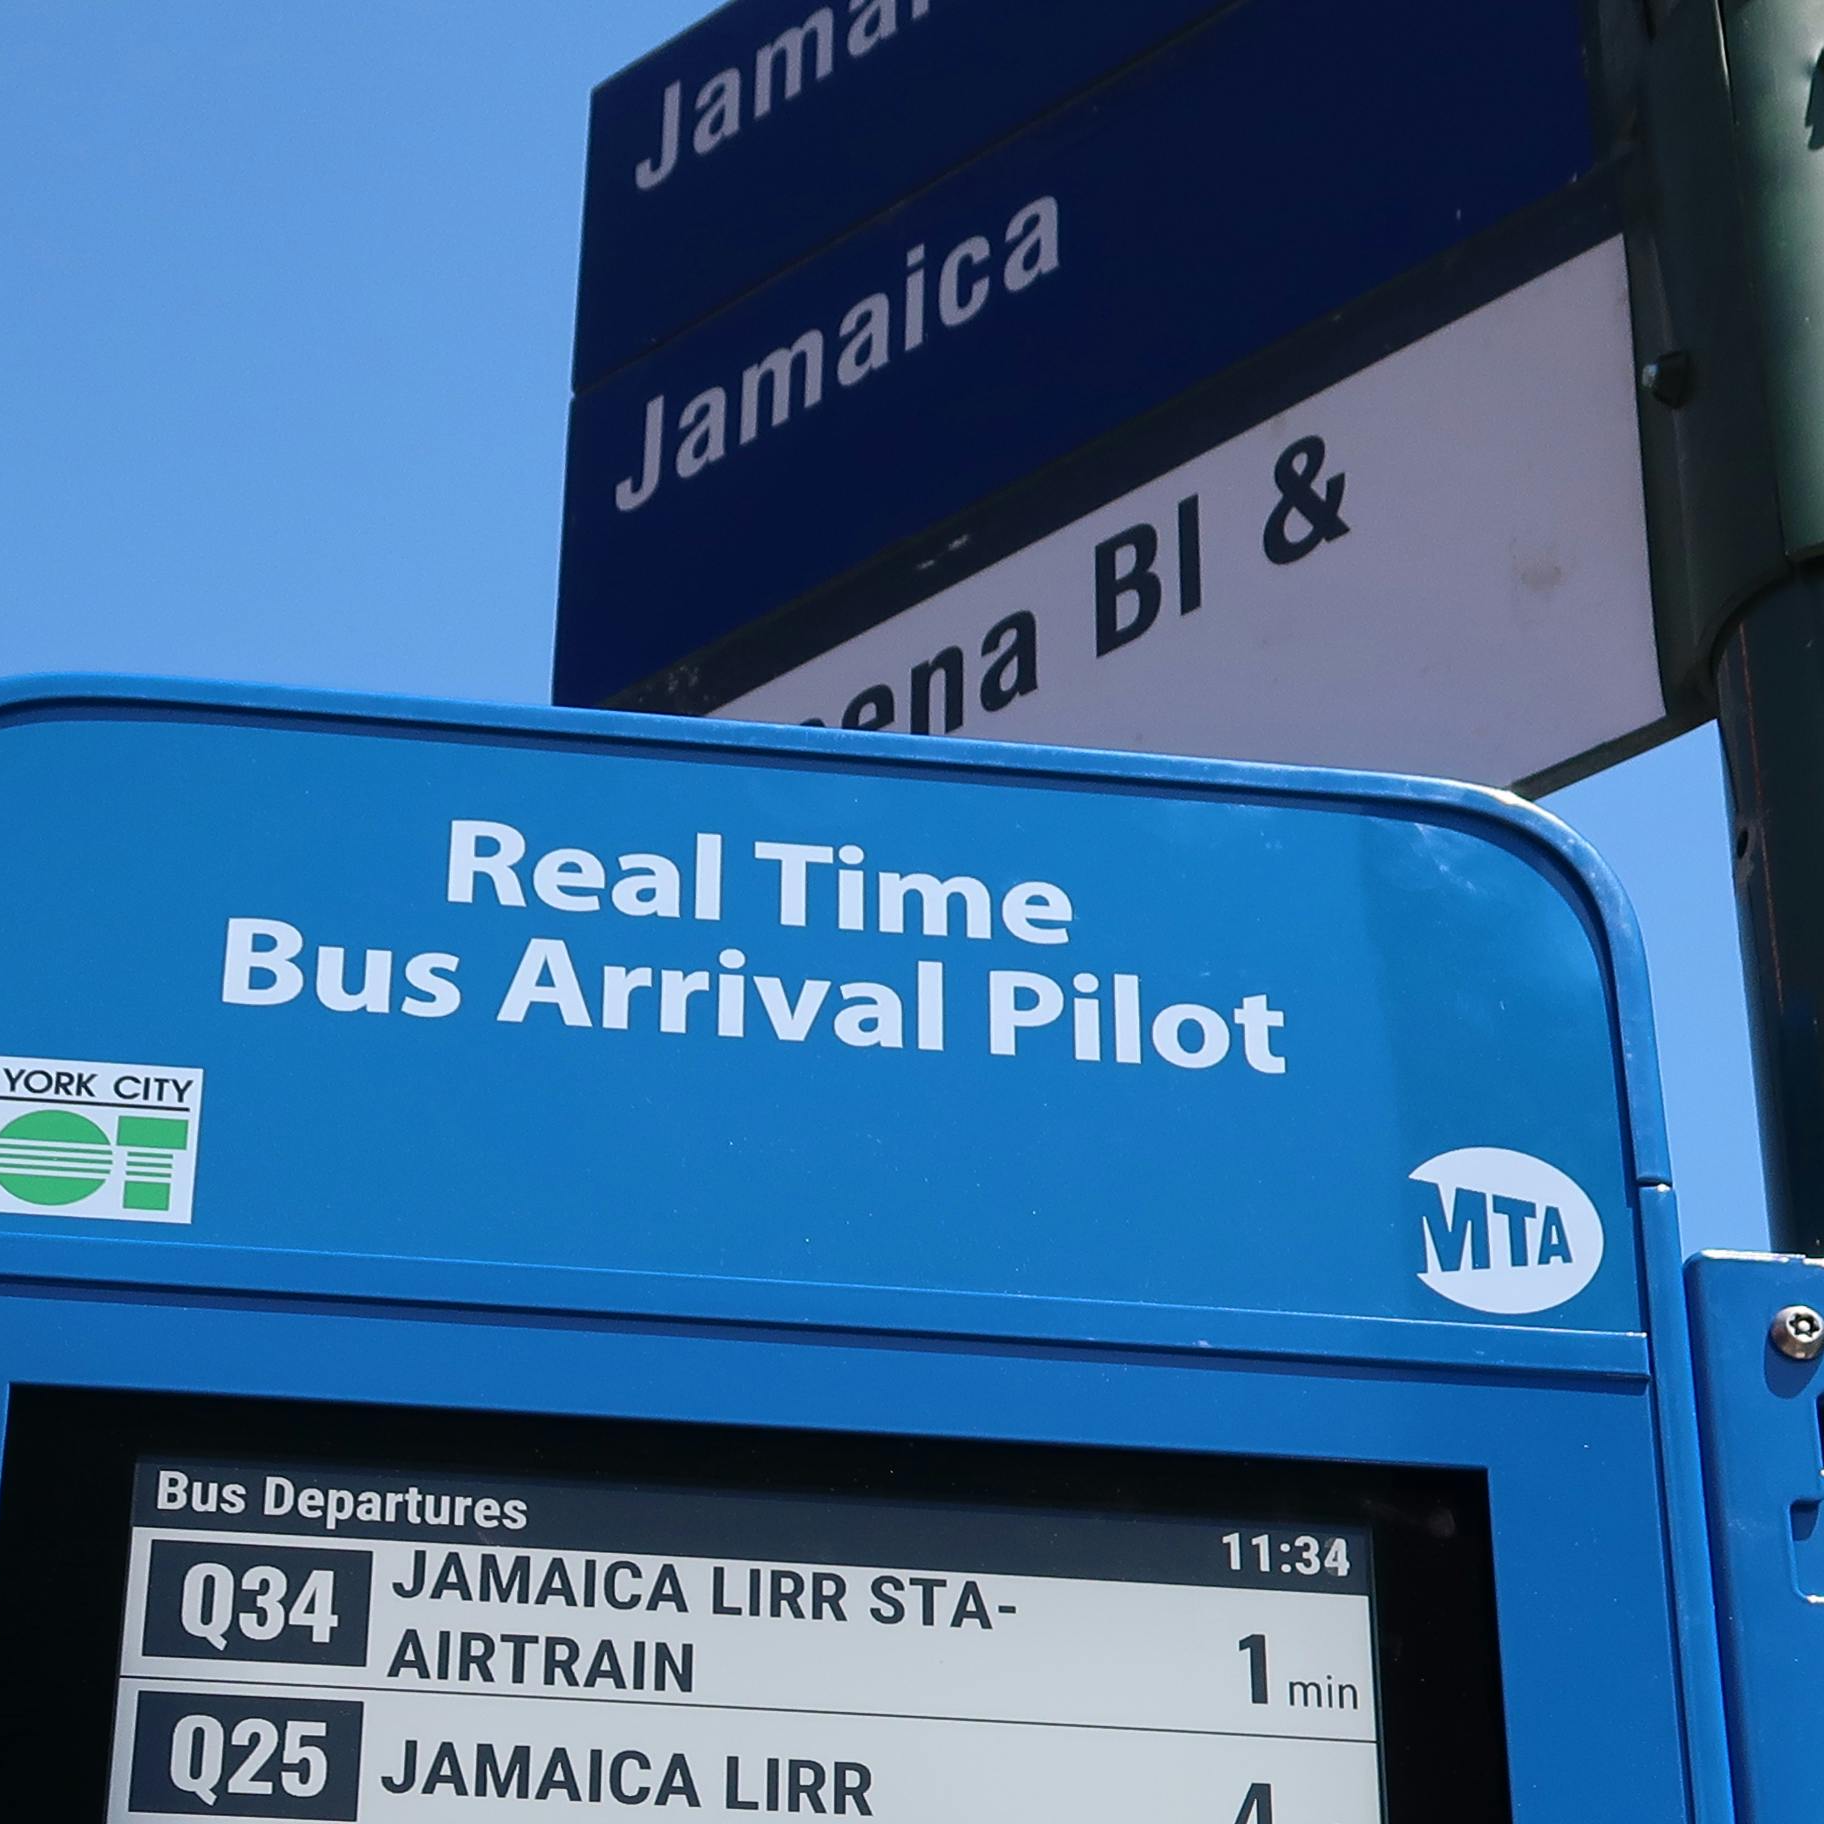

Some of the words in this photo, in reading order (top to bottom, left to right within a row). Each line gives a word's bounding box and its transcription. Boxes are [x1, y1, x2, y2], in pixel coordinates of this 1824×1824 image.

[635, 0, 929, 190] Jama
[615, 195, 1060, 511] Jamaica
[798, 609, 1039, 735] ena
[1094, 495, 1201, 657] Bl
[1264, 435, 1351, 565] &
[447, 819, 722, 922] Real
[754, 841, 1074, 944] Time
[221, 918, 460, 1017] Bus
[497, 938, 943, 1051] Arrival
[987, 969, 1287, 1075] Pilot
[4, 1068, 97, 1097] YORK
[113, 1076, 193, 1103] CITY
[1423, 1181, 1573, 1272] MTA
[156, 1470, 246, 1514] Bus
[264, 1477, 528, 1531] Departures
[392, 1550, 689, 1613] JAMAICA
[713, 1567, 848, 1622] LIRR
[870, 1575, 1018, 1631] STA-
[1221, 1532, 1351, 1577] 11:34
[180, 1562, 338, 1652] Q34
[388, 1629, 694, 1693] AIRTRAIN
[1238, 1633, 1268, 1705] 1
[1289, 1675, 1359, 1710] min
[169, 1715, 327, 1806] Q25
[380, 1740, 702, 1808] JAMAICA
[725, 1756, 874, 1816] LIRR
